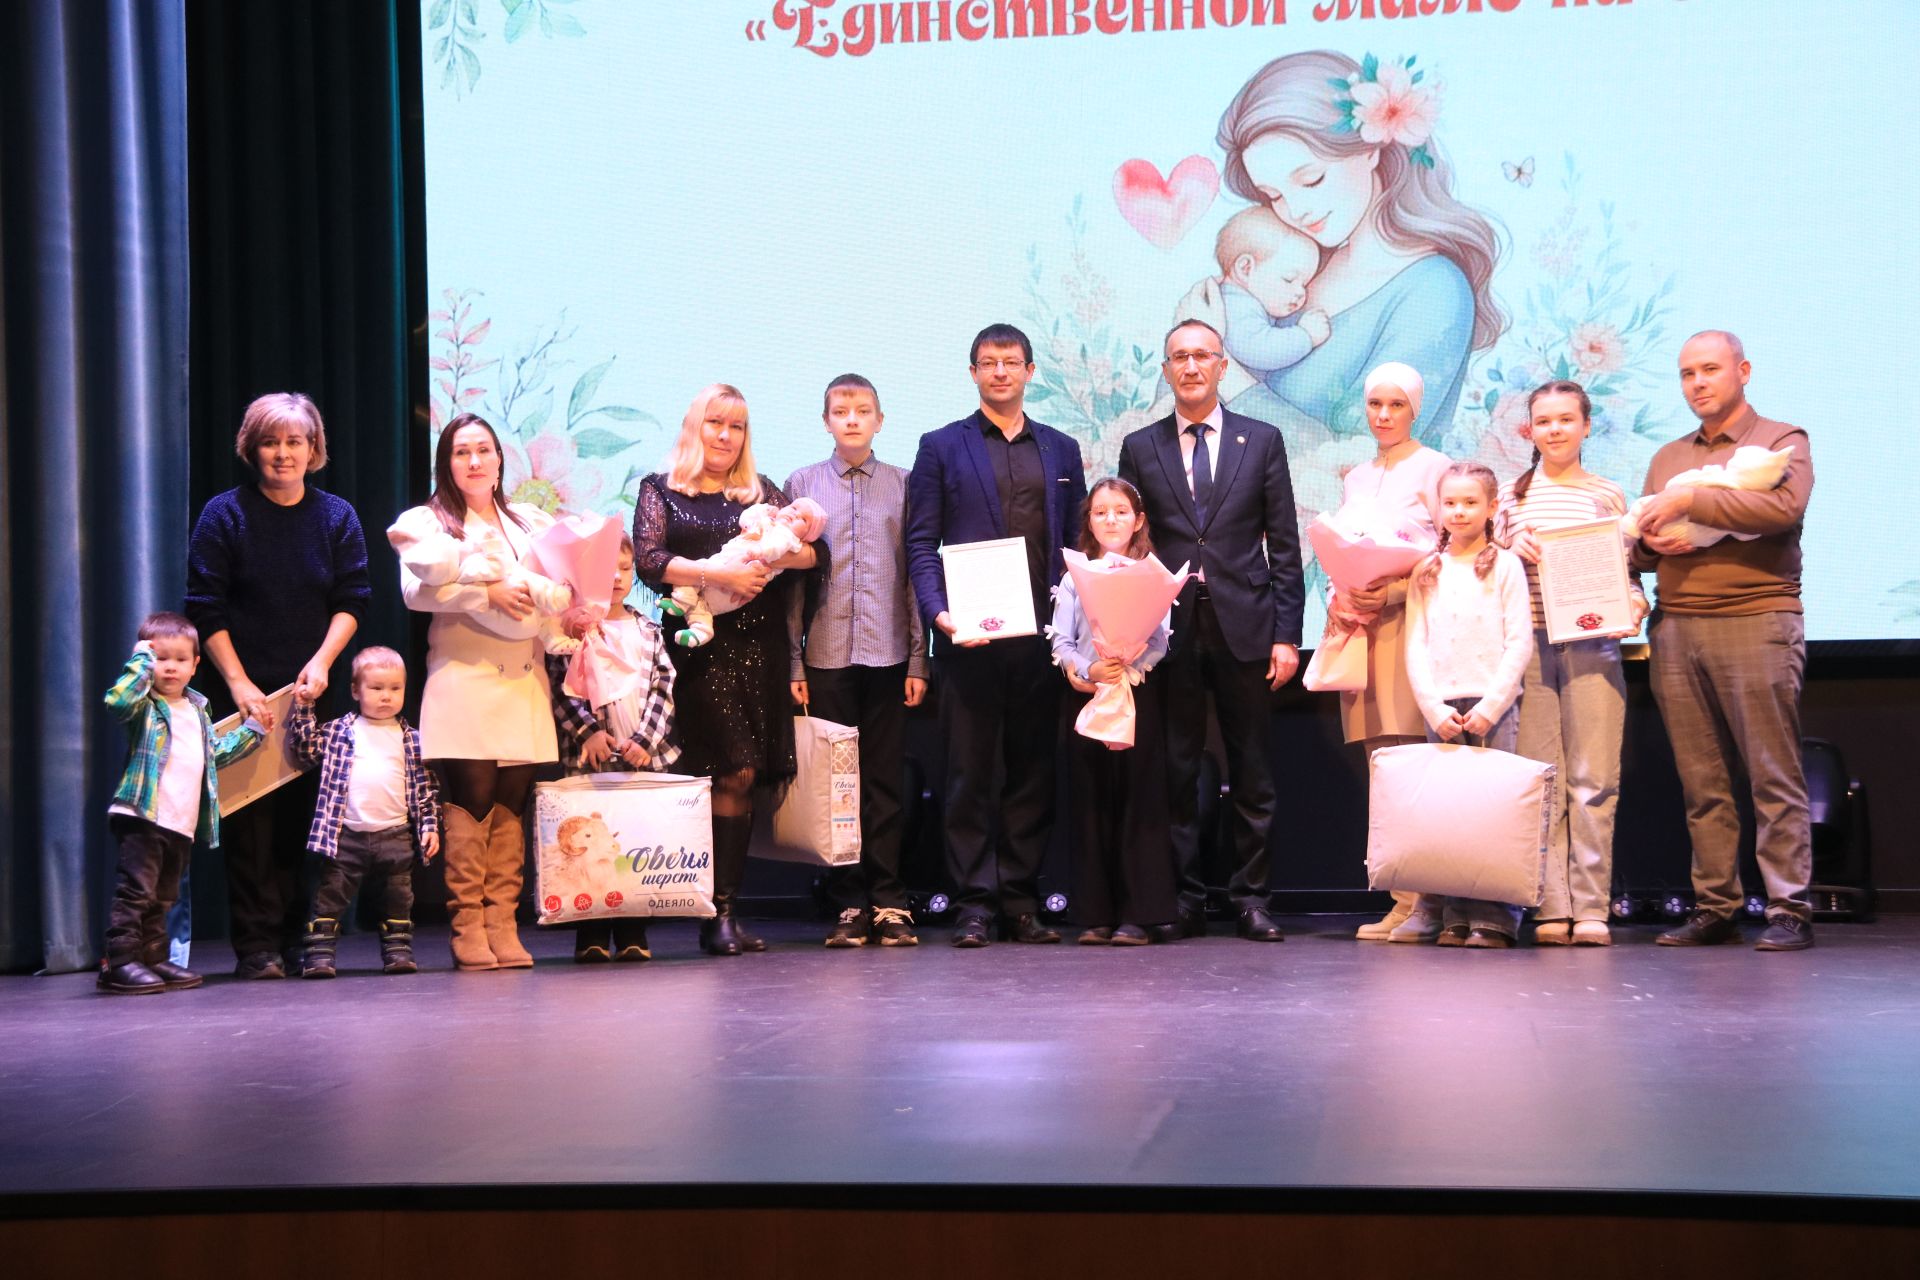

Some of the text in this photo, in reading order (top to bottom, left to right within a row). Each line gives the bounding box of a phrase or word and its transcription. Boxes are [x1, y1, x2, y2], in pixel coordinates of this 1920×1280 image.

[625, 844, 710, 873] Овечья
[641, 872, 699, 890] шерсть
[648, 898, 695, 908] ОДЕЯЛО
